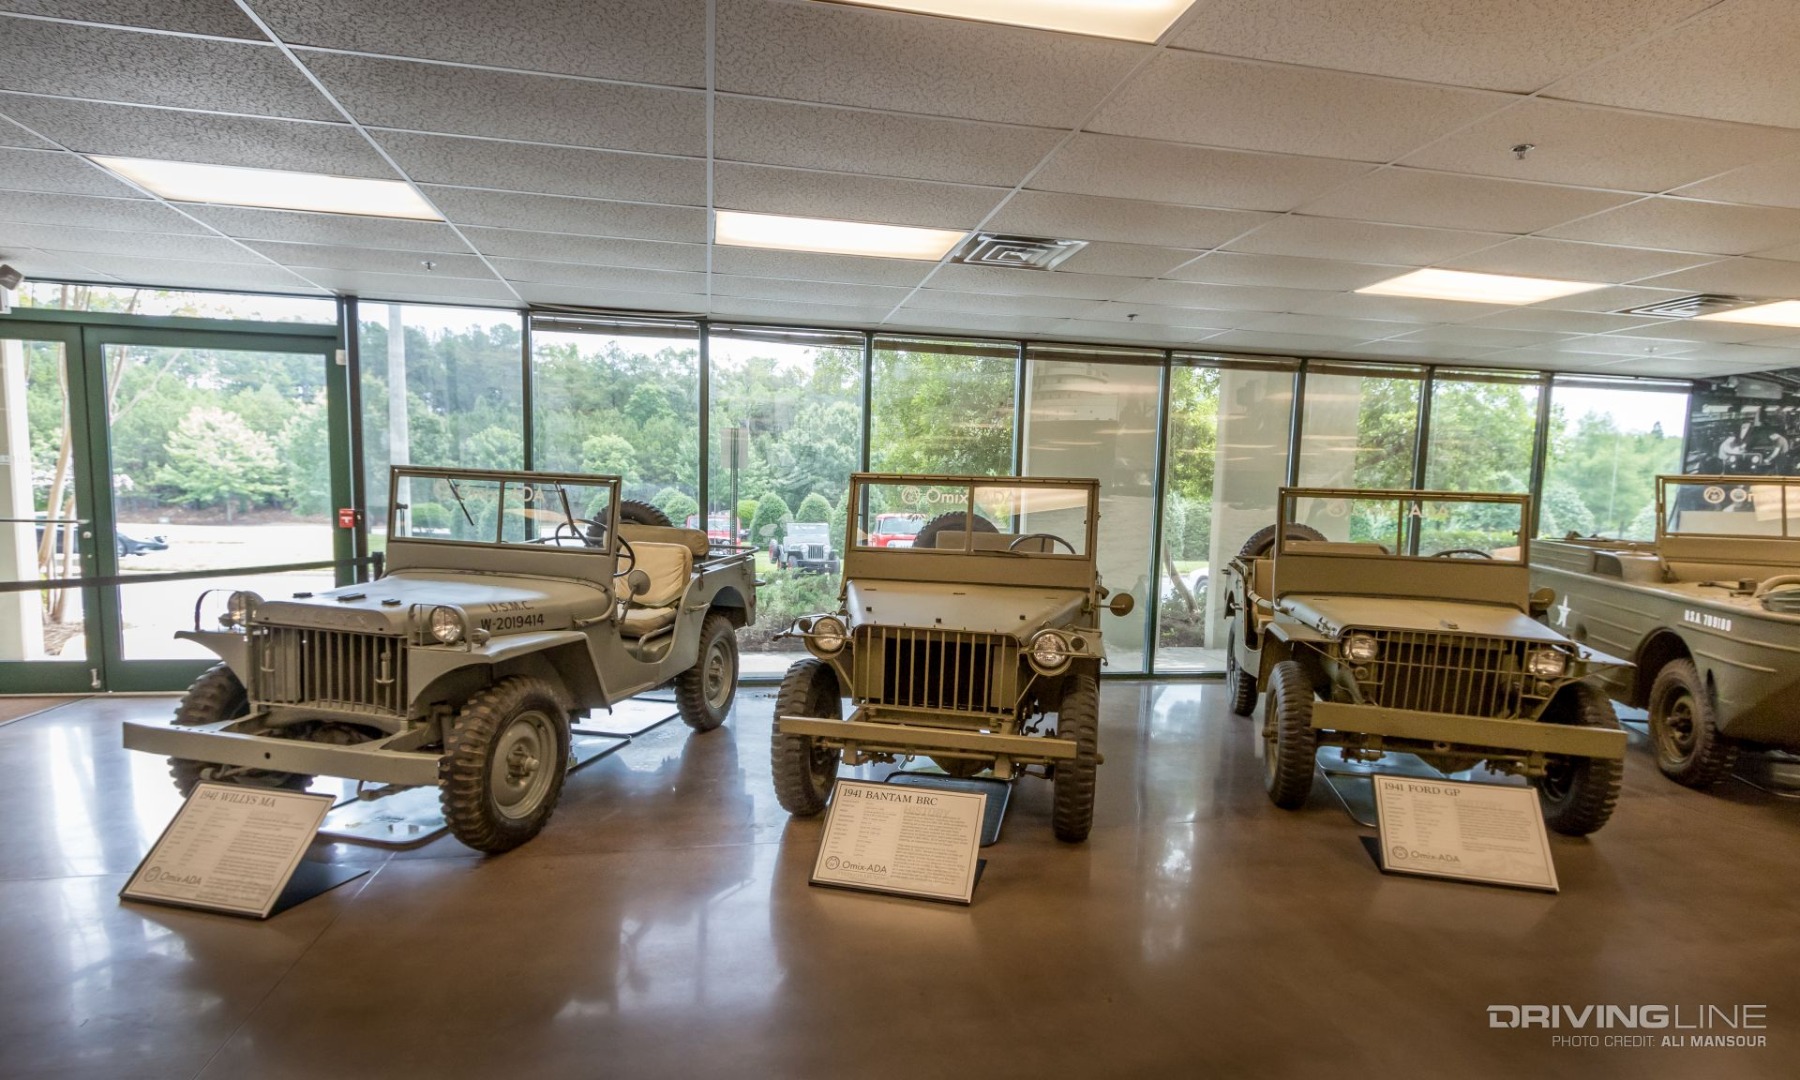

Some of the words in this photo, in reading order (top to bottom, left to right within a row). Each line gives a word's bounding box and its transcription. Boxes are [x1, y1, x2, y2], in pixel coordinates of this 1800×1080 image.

[481, 613, 544, 631] W-2019414
[843, 788, 863, 798] 1941
[865, 790, 912, 804] BANTAM
[916, 796, 938, 806] BRC
[1384, 782, 1404, 792] 1941
[1408, 784, 1441, 795] FORD
[1444, 788, 1461, 797] GP
[199, 790, 219, 801] 1941
[220, 792, 259, 805] WILLYS
[258, 796, 277, 808] MA
[1410, 850, 1461, 863] Omix-ADA
[842, 860, 888, 874] Omix-ADA
